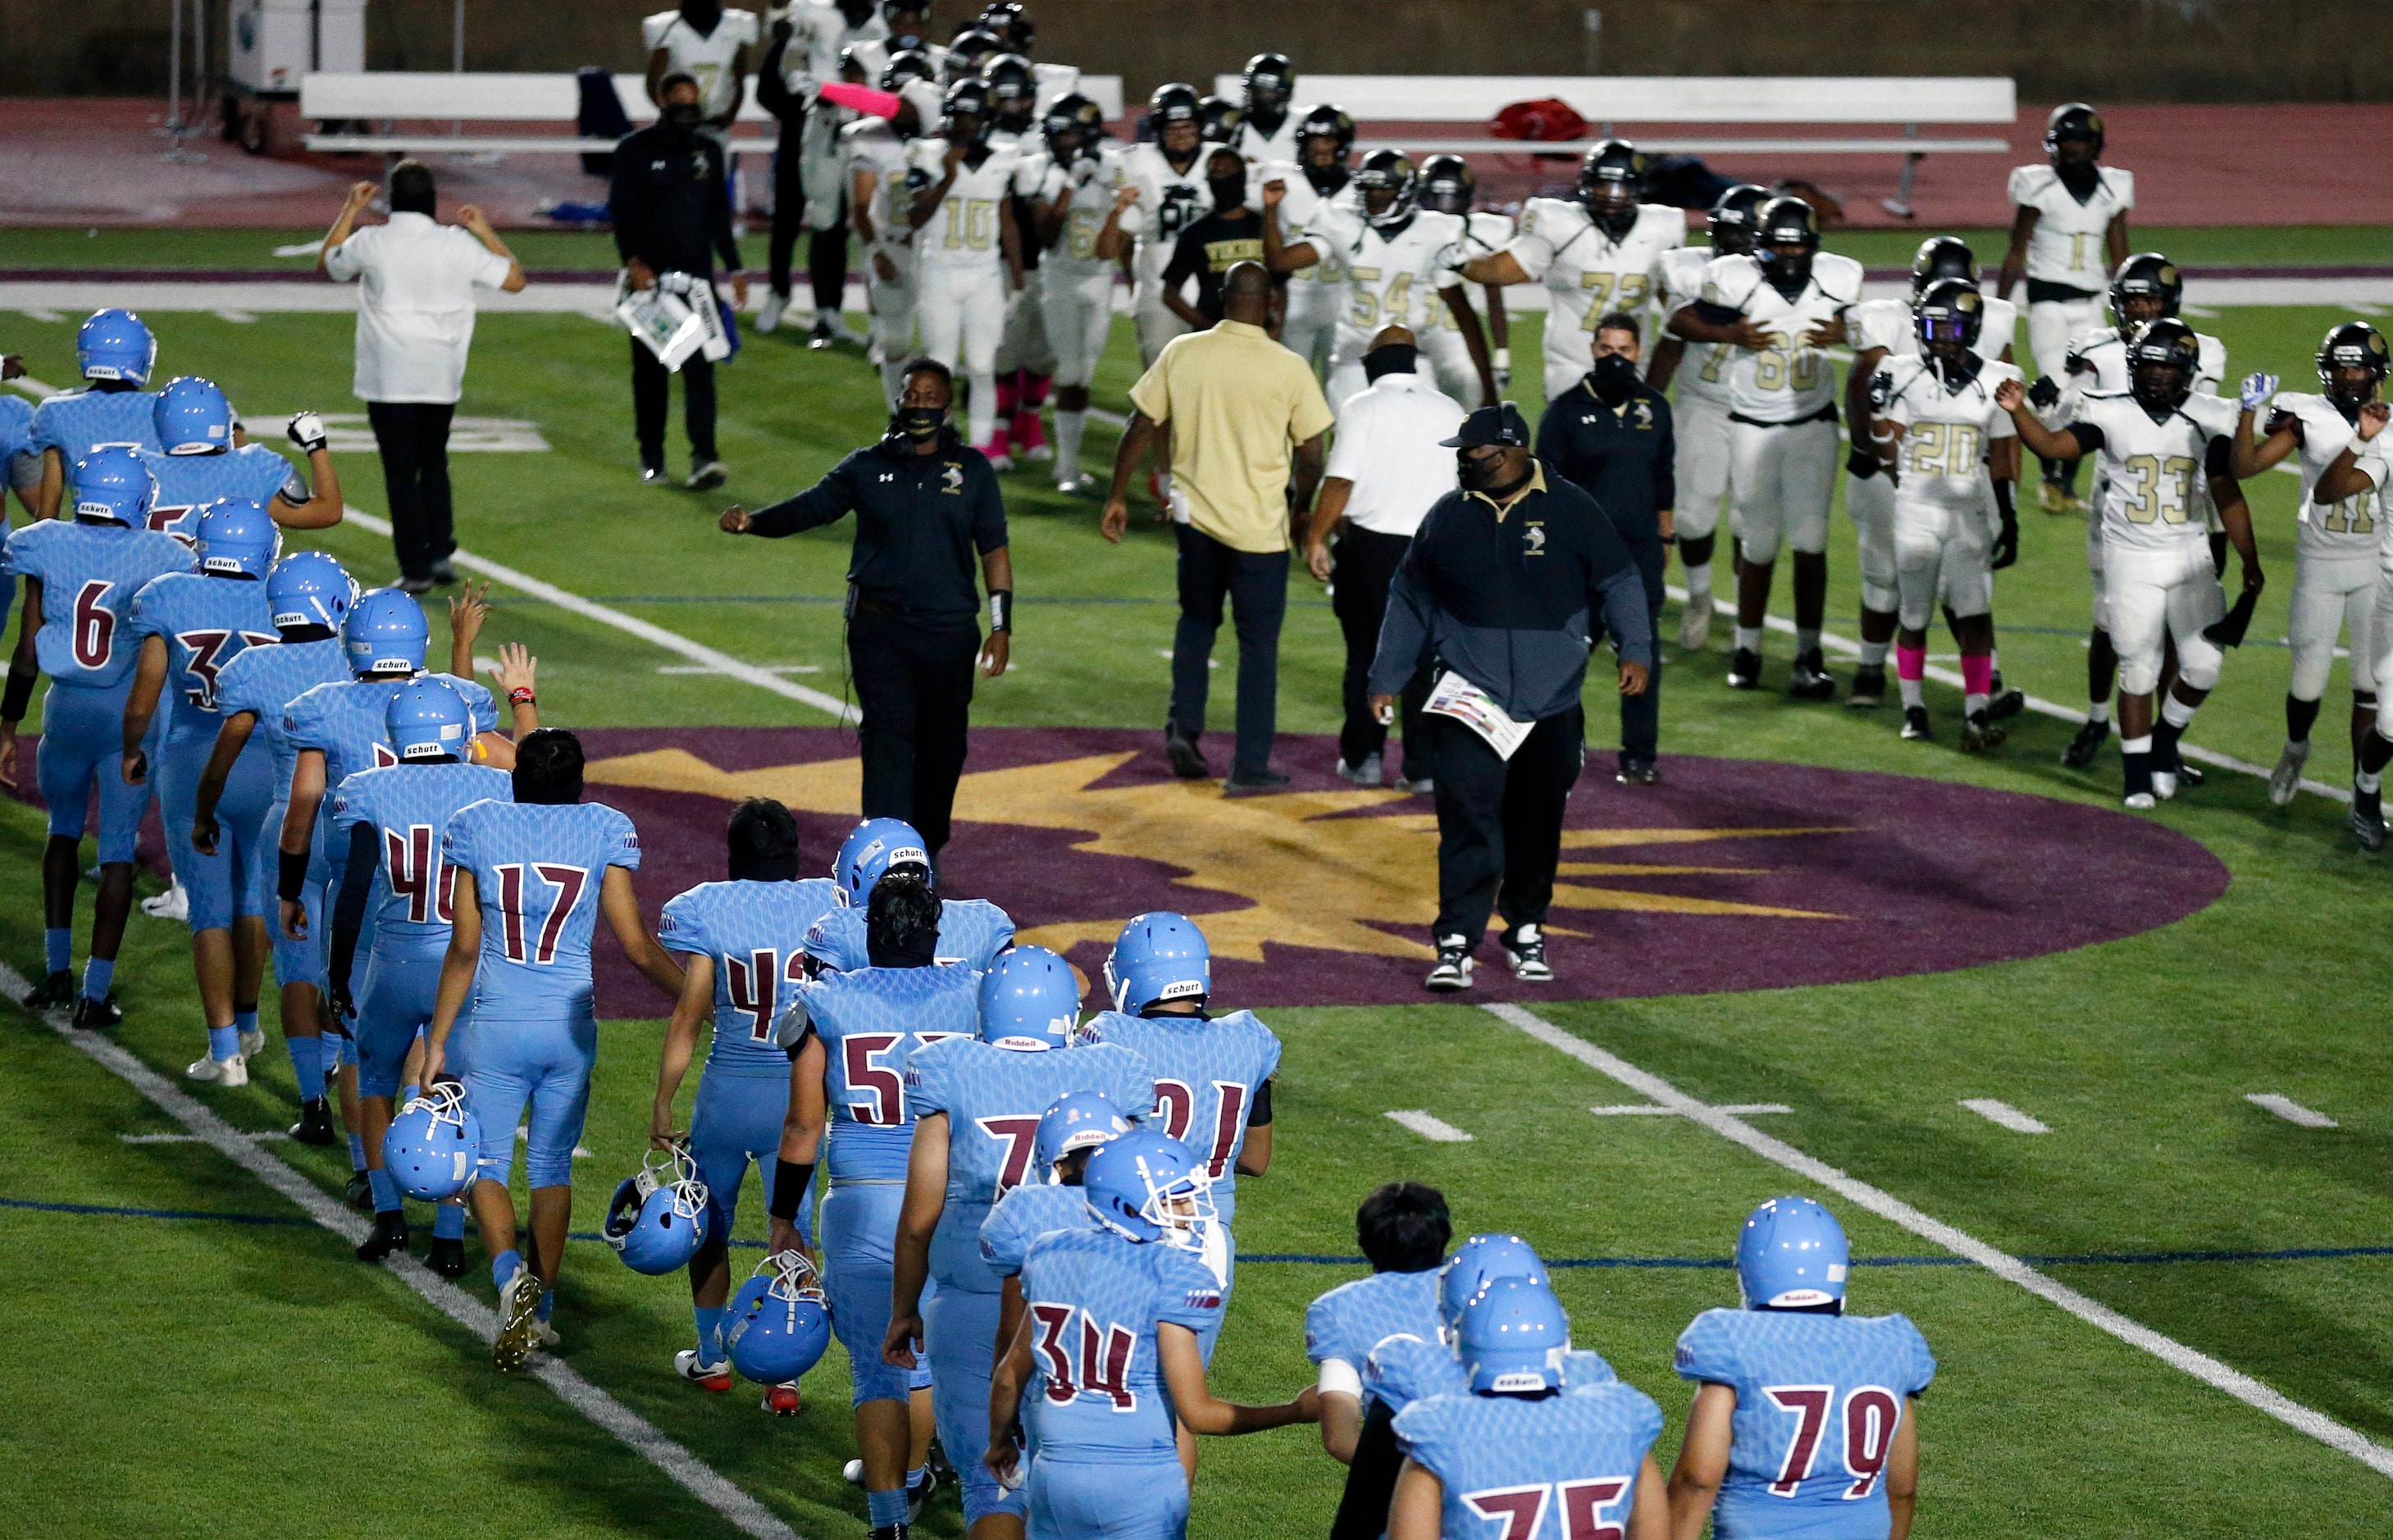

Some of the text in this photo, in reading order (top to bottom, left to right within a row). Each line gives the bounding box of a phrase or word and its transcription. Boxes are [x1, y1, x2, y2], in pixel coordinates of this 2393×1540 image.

[943, 197, 997, 250] 10
[2069, 231, 2085, 271] 1
[1349, 265, 1415, 327] 54
[1912, 421, 1978, 476] 20
[80, 503, 109, 514] schutt
[2125, 453, 2198, 525] 33
[207, 559, 238, 569] schutt
[72, 579, 116, 671] 6
[175, 628, 280, 713] 3
[376, 659, 408, 670] schutt
[407, 745, 439, 755] schutt
[893, 849, 923, 859] schutt
[493, 863, 590, 965] 17
[1167, 983, 1200, 996] schutt
[1005, 1039, 1037, 1047] Riddell
[841, 1032, 975, 1128] 5
[1074, 1132, 1106, 1142] Riddell
[1029, 1301, 1137, 1413] 34
[1762, 1384, 1901, 1500] 79
